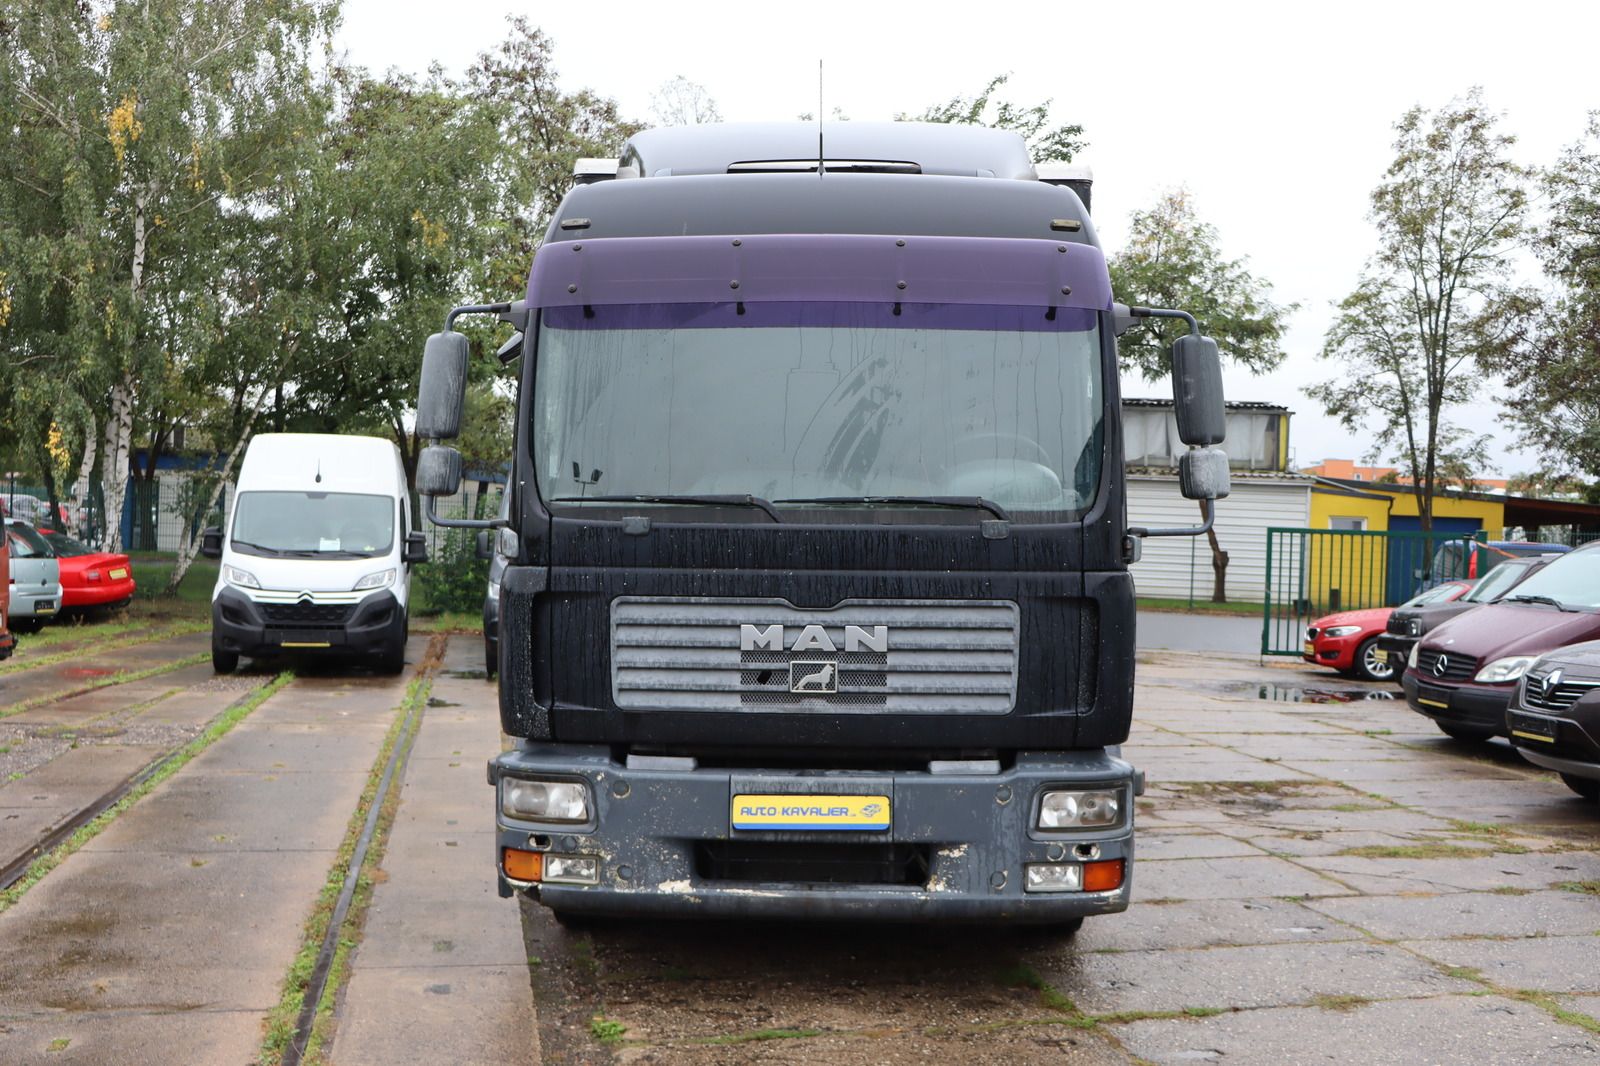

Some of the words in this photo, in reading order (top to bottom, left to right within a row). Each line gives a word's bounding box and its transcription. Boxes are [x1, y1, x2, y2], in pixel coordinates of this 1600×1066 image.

[740, 624, 888, 652] MAN
[740, 806, 777, 817] AUTO
[781, 806, 849, 817] KAVALIER
